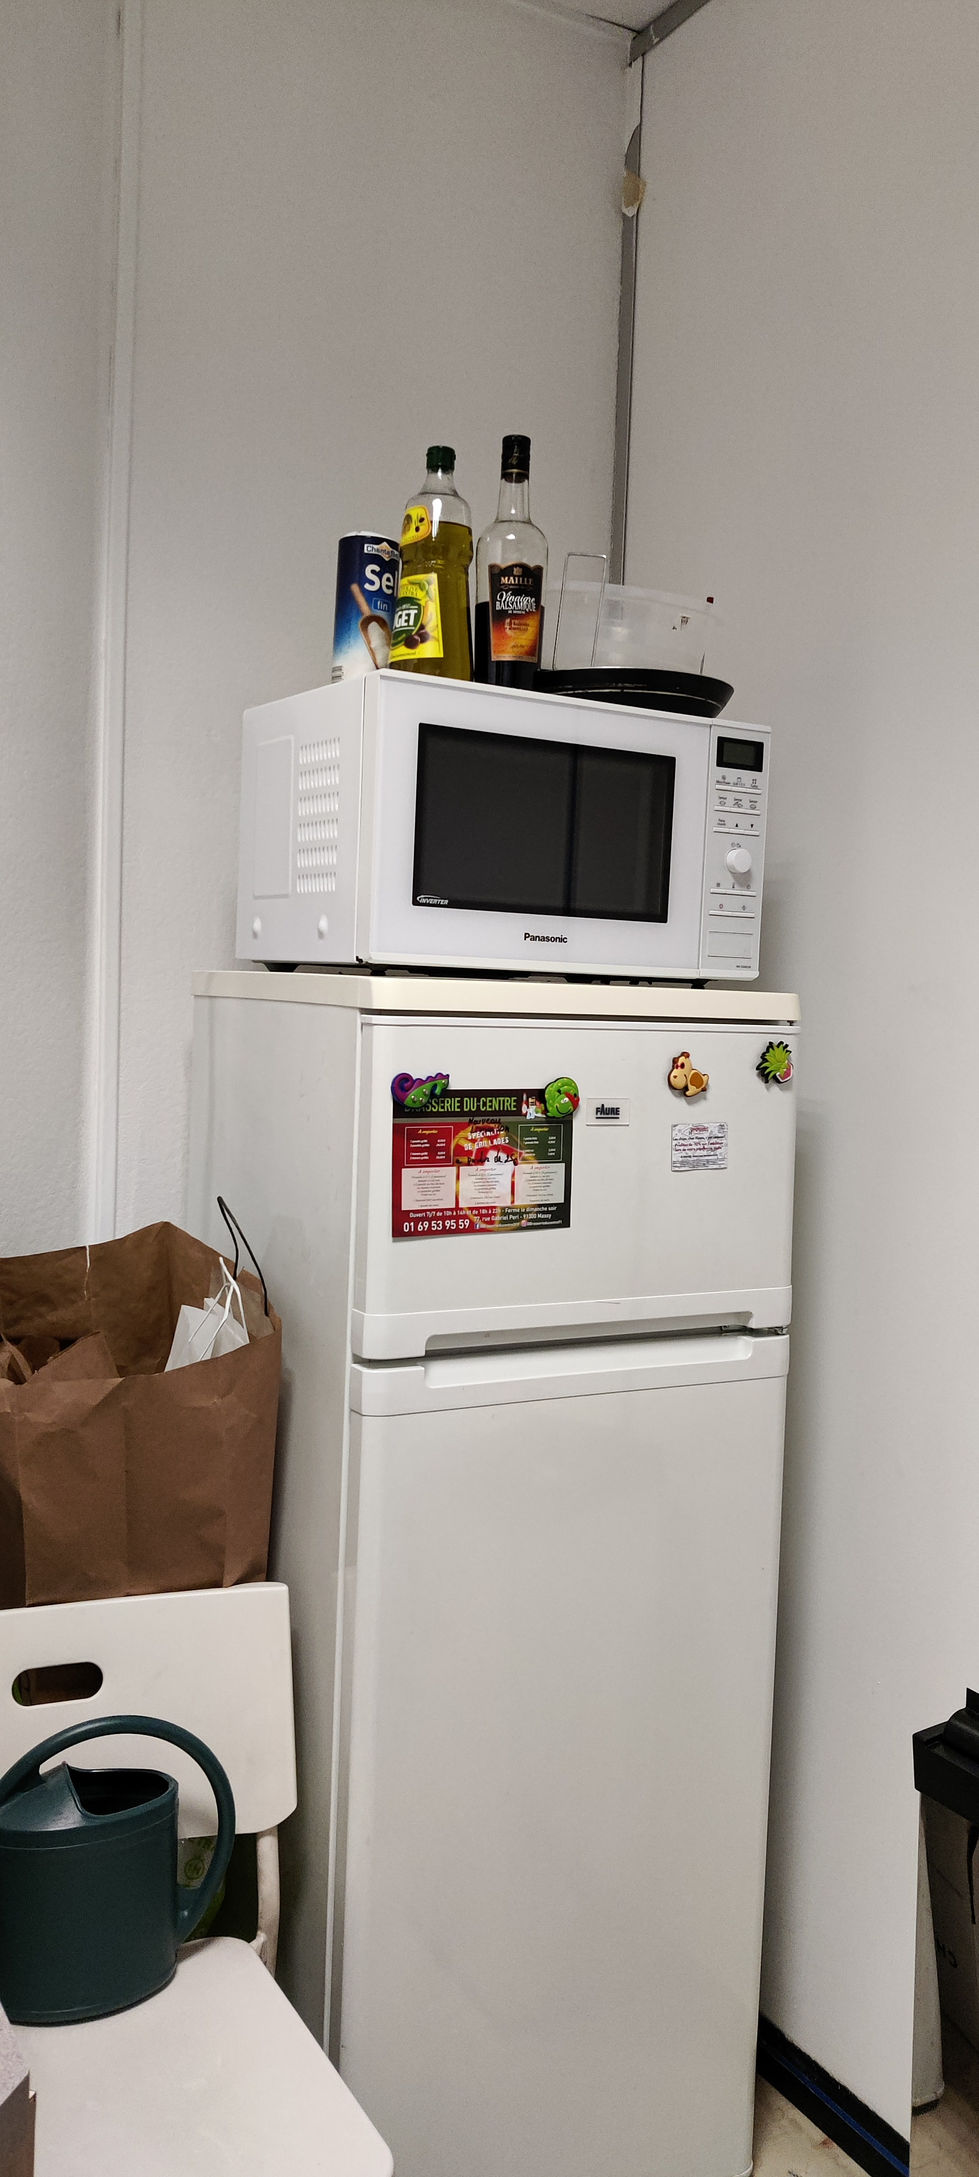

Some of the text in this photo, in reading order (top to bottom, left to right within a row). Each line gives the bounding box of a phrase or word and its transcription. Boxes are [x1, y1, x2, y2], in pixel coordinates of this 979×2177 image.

[364, 564, 398, 597] Sel
[500, 576, 534, 584] MAILLE
[496, 591, 536, 605] Vinaigre
[377, 600, 388, 610] fin
[496, 600, 536, 612] BALSAMIQUE
[419, 896, 449, 905] INVERTER
[524, 932, 568, 944] Panasonic
[464, 1097, 477, 1111] DU
[480, 1096, 517, 1111] CENTRE
[595, 1104, 620, 1116] FAURE
[403, 1222, 414, 1232] 01
[417, 1221, 428, 1231] 69
[431, 1220, 442, 1230] 53
[445, 1220, 456, 1230] 95
[459, 1219, 470, 1229] 59
